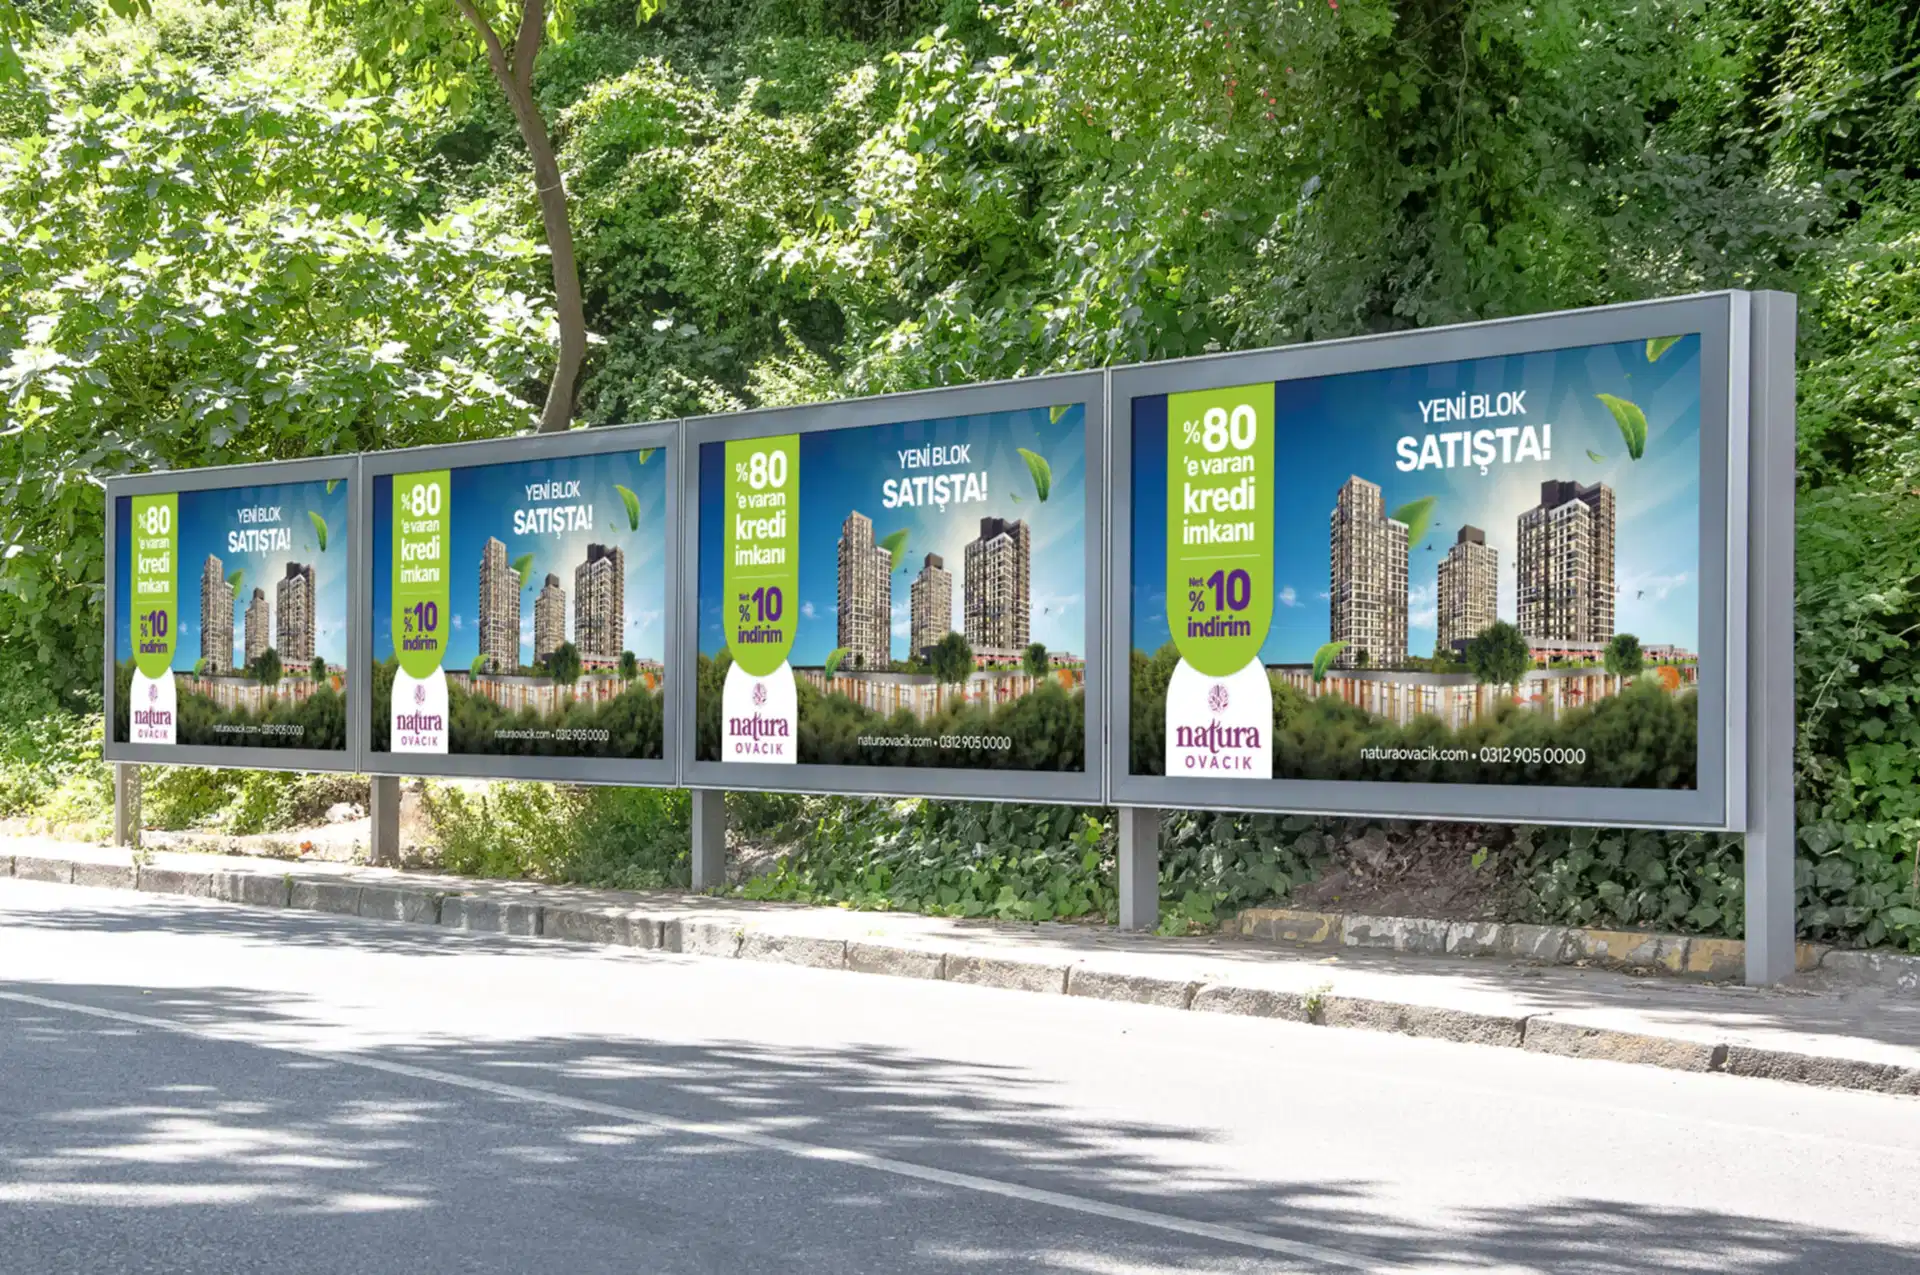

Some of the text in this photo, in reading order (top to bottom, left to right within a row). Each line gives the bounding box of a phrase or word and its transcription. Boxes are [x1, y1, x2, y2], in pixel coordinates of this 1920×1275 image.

[1418, 390, 1526, 424] YENİ BLOK
[898, 443, 971, 470] YENİ BLOK
[1396, 423, 1551, 475] SATIŞTA!
[1199, 455, 1254, 475] varan
[526, 480, 580, 501] YENİ BLOK
[747, 494, 785, 507] varan
[883, 471, 988, 512] SATIŞTA!
[1183, 479, 1255, 513] kredi
[237, 505, 281, 523] YENİ BLOK
[514, 504, 593, 540] SATIŞTA!
[411, 521, 439, 532] varan
[736, 510, 786, 540] kredi
[1182, 518, 1254, 545] imkanı
[228, 528, 291, 557] SATIŞTA!
[401, 536, 440, 561] kredi
[138, 552, 170, 575] kredi
[735, 545, 785, 566] imkanı
[401, 565, 440, 583] imkanı
[1188, 576, 1204, 588] Net
[738, 625, 783, 644] indirim
[1187, 615, 1251, 639] indirim
[140, 639, 168, 654] indirim
[403, 634, 437, 651] indirim
[135, 706, 171, 727] natura
[397, 710, 442, 735] natura
[729, 712, 789, 741] natura
[138, 728, 168, 739] OVACIK
[401, 736, 438, 746] OVACIK
[587, 729, 609, 741] 0000
[858, 734, 1011, 750] naturaovacik.com 0312 905 0000
[1176, 718, 1261, 754] natura
[736, 742, 783, 755] OVACIK
[1361, 744, 1585, 765] naturaovacik.com 0312 905 0000
[1185, 755, 1253, 769] OVACIK
